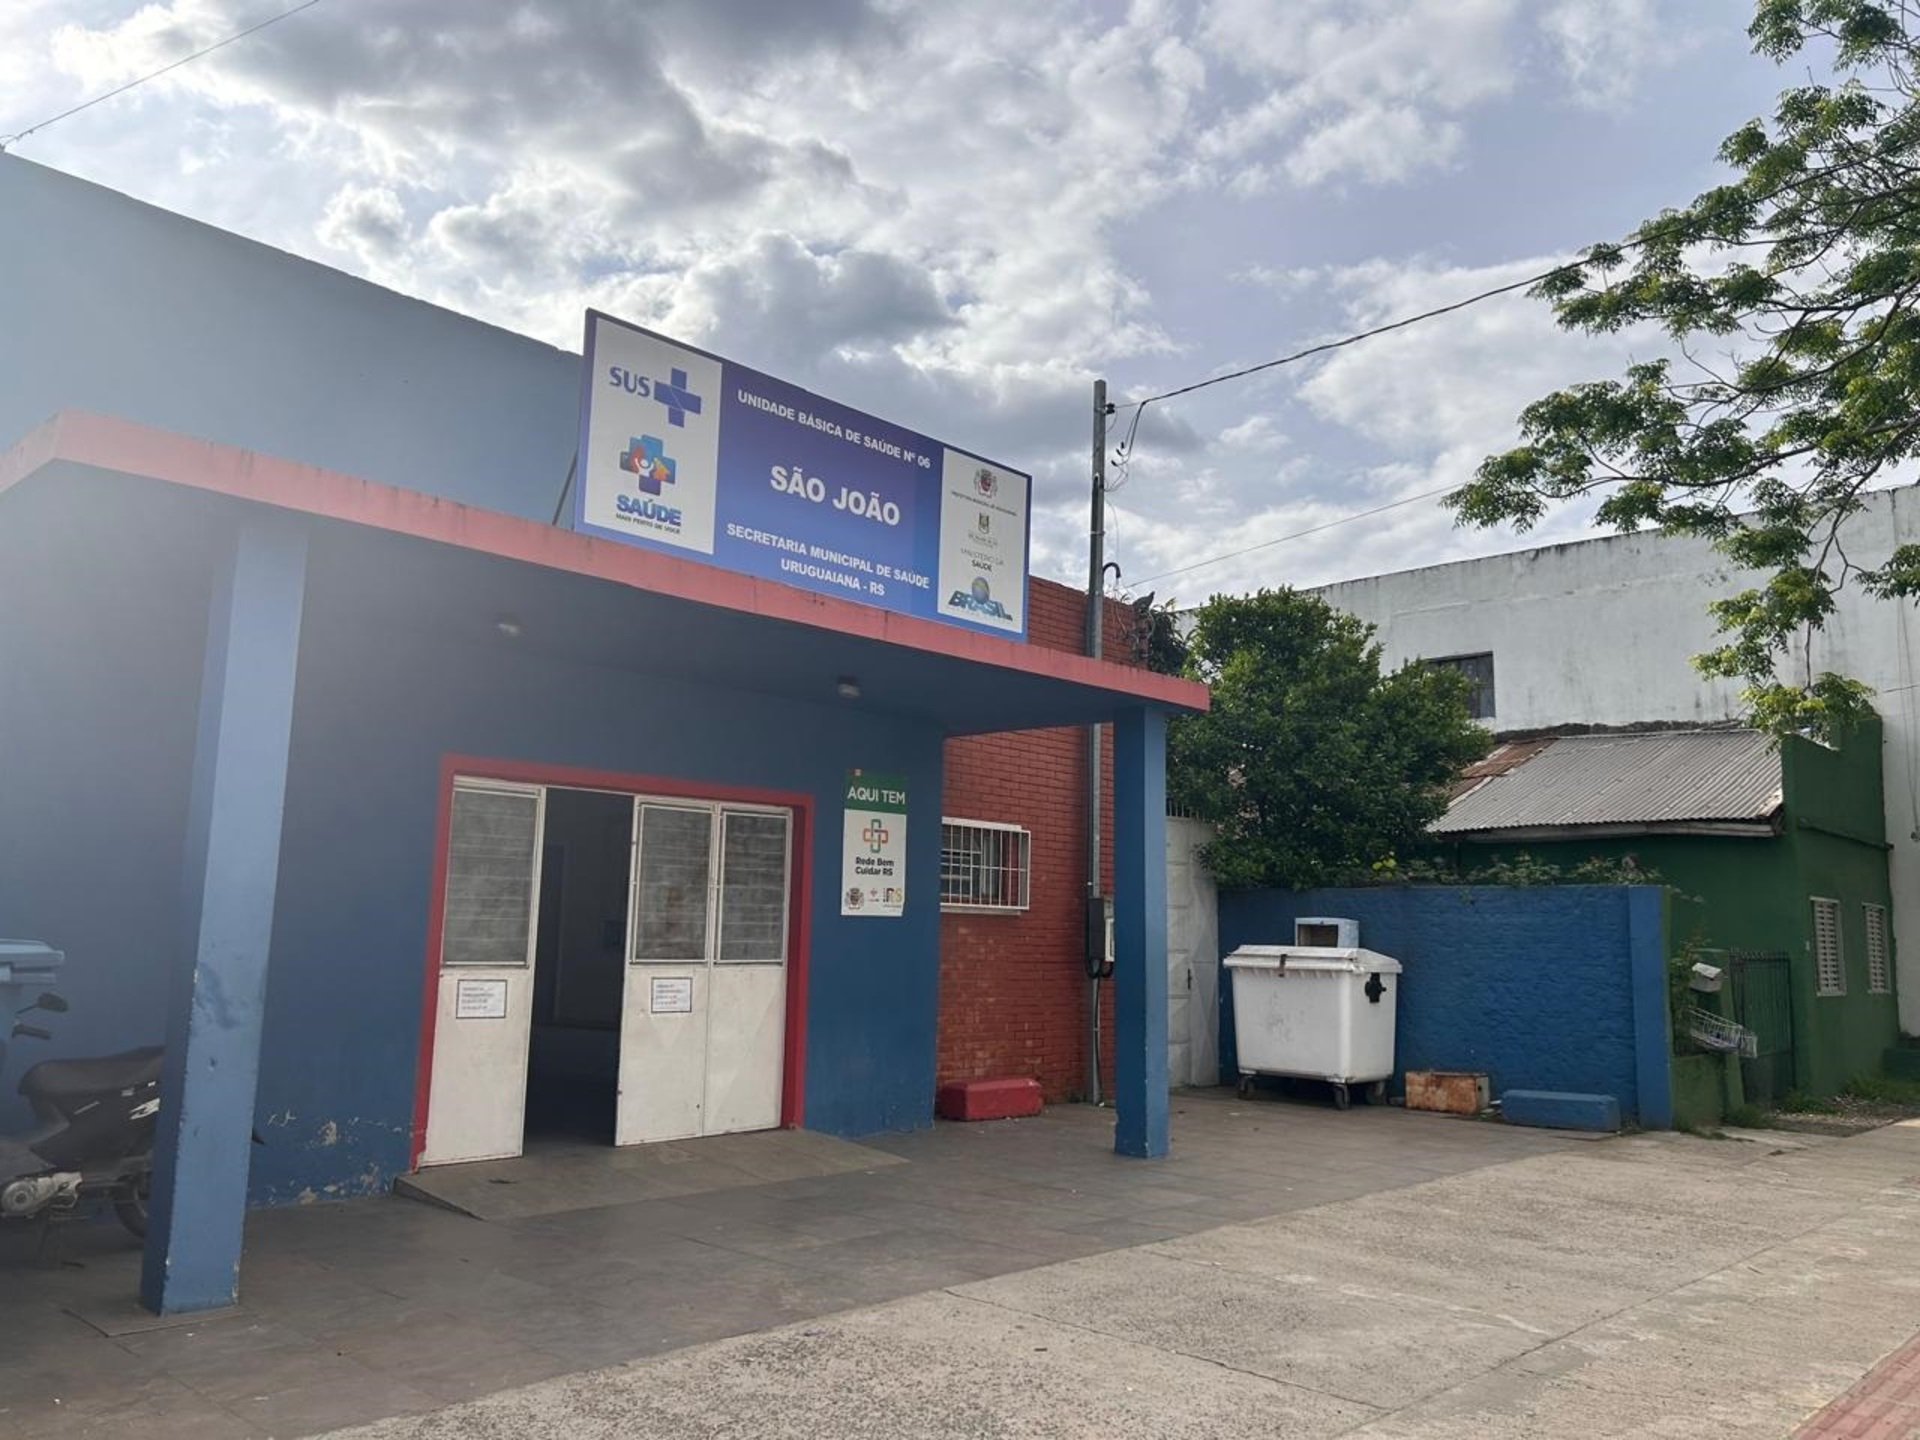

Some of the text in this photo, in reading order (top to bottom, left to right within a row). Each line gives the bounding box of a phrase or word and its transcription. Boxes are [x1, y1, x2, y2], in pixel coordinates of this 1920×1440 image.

[609, 366, 650, 397] SUS
[737, 389, 795, 421] UNIDADE
[798, 411, 843, 438] BÁSICA
[845, 429, 861, 444] DE
[863, 437, 901, 459] SAÚDE
[917, 455, 931, 469] 06
[616, 494, 682, 527] SAÚDE
[770, 465, 901, 526] SÃO JOÃO
[726, 523, 807, 556] SECRETARIA
[810, 546, 873, 574] MUNICIPAL
[876, 564, 891, 578] DE
[780, 558, 861, 591] URUGUAIANA
[869, 583, 885, 596] RS
[847, 786, 906, 804] AQUI TEM
[855, 857, 894, 867] Rede Bem
[855, 866, 893, 876] Cuidar RS
